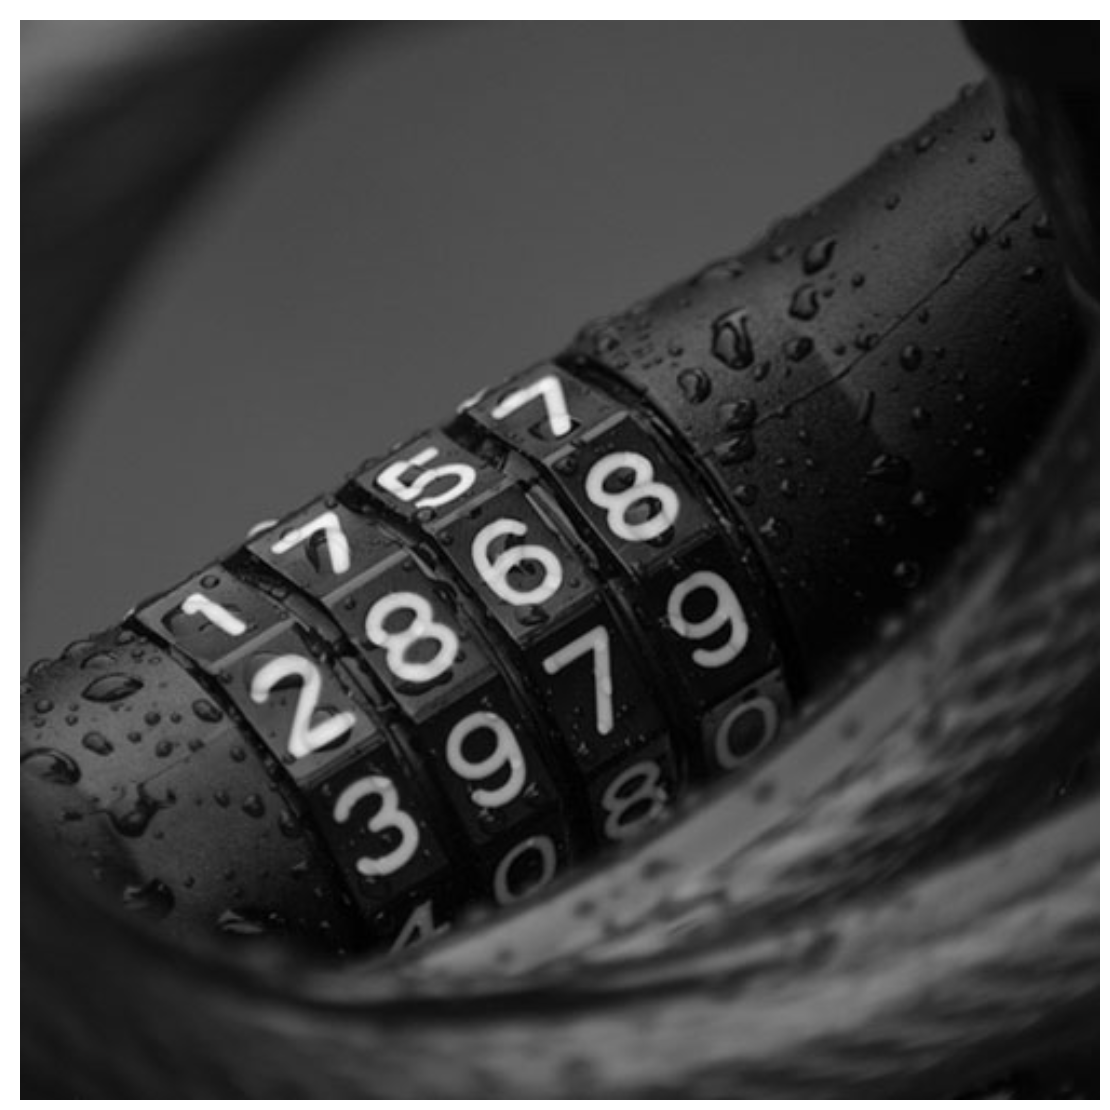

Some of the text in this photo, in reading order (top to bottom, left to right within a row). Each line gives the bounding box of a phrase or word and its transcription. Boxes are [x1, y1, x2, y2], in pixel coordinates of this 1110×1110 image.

[180, 375, 571, 636] 1 7 5 7
[250, 451, 679, 757] 2 8 6 8
[333, 570, 749, 876] 3 9 7 9
[602, 759, 668, 838] 8
